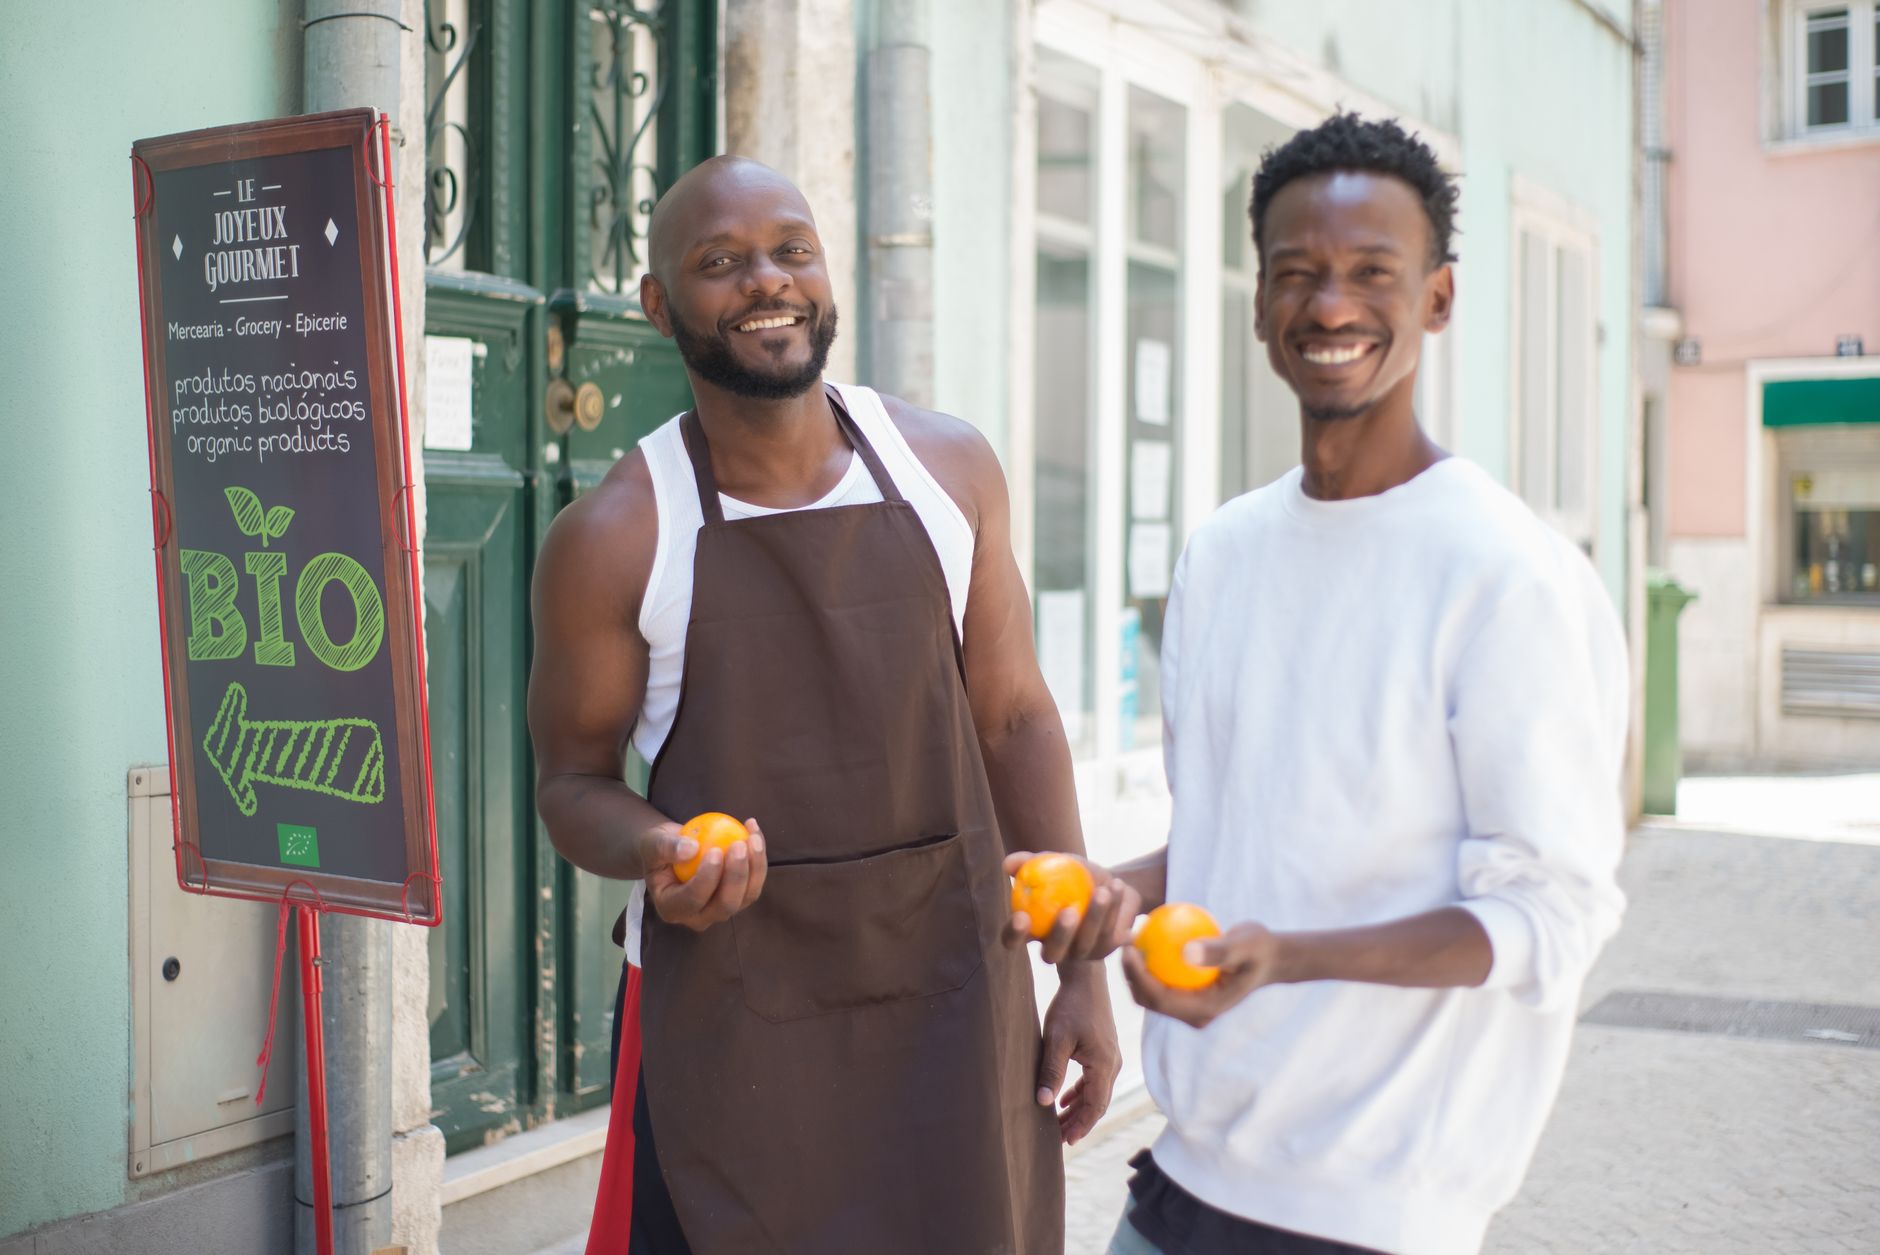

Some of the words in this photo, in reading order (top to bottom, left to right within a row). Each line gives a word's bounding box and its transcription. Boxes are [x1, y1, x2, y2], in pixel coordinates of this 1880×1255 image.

[237, 178, 256, 203] LE
[213, 205, 289, 246] JOYEUX
[204, 244, 300, 292] GOURMET
[168, 320, 224, 340] Mercearia
[235, 316, 282, 339] Grocery
[295, 312, 348, 337] Epicerie
[175, 366, 256, 404] produtos
[261, 360, 357, 393] nacionais
[172, 397, 253, 434] produtos
[258, 391, 366, 430] biológicos
[187, 426, 253, 463] organic
[258, 425, 351, 463] products
[180, 550, 385, 672] BIO
